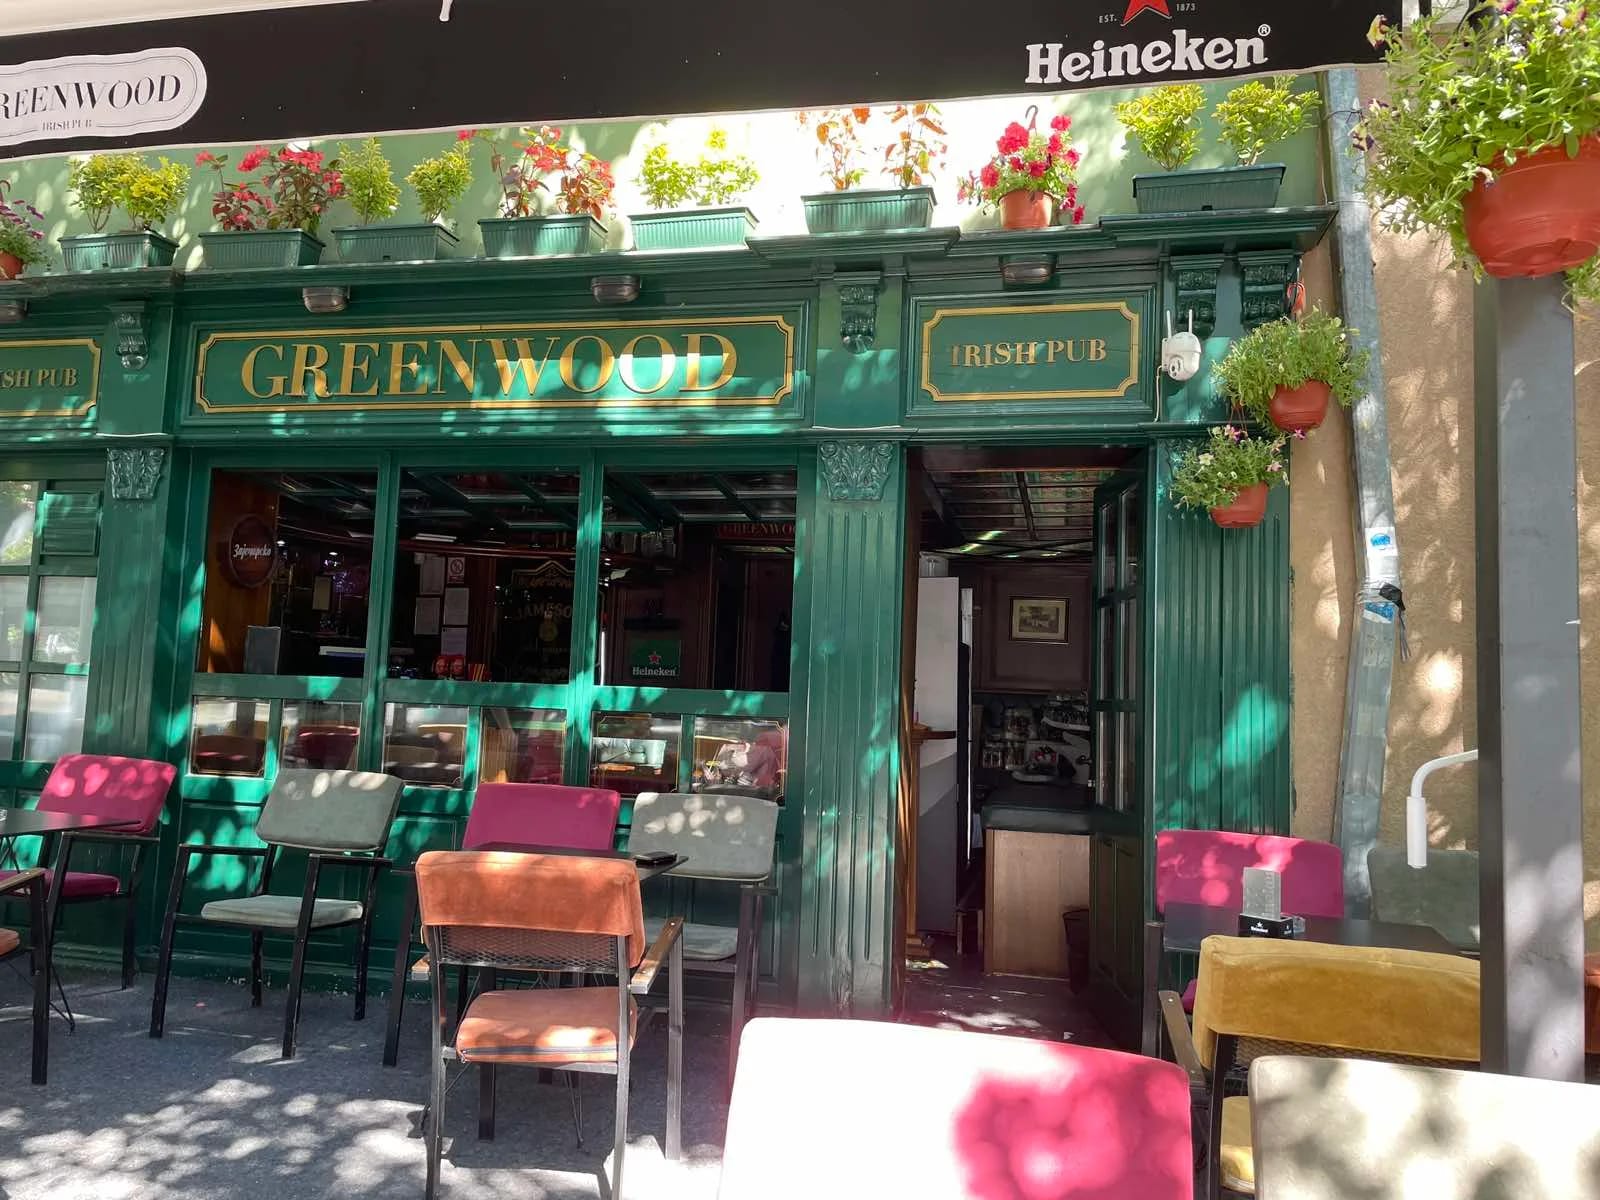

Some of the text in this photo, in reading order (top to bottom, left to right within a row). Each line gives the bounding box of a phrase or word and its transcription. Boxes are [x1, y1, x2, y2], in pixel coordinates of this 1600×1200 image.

[1099, 2, 1196, 24] EST. 1873
[952, 338, 1107, 367] IRISH PUB
[37, 367, 77, 387] PUB
[240, 332, 738, 399] GREENWOOD
